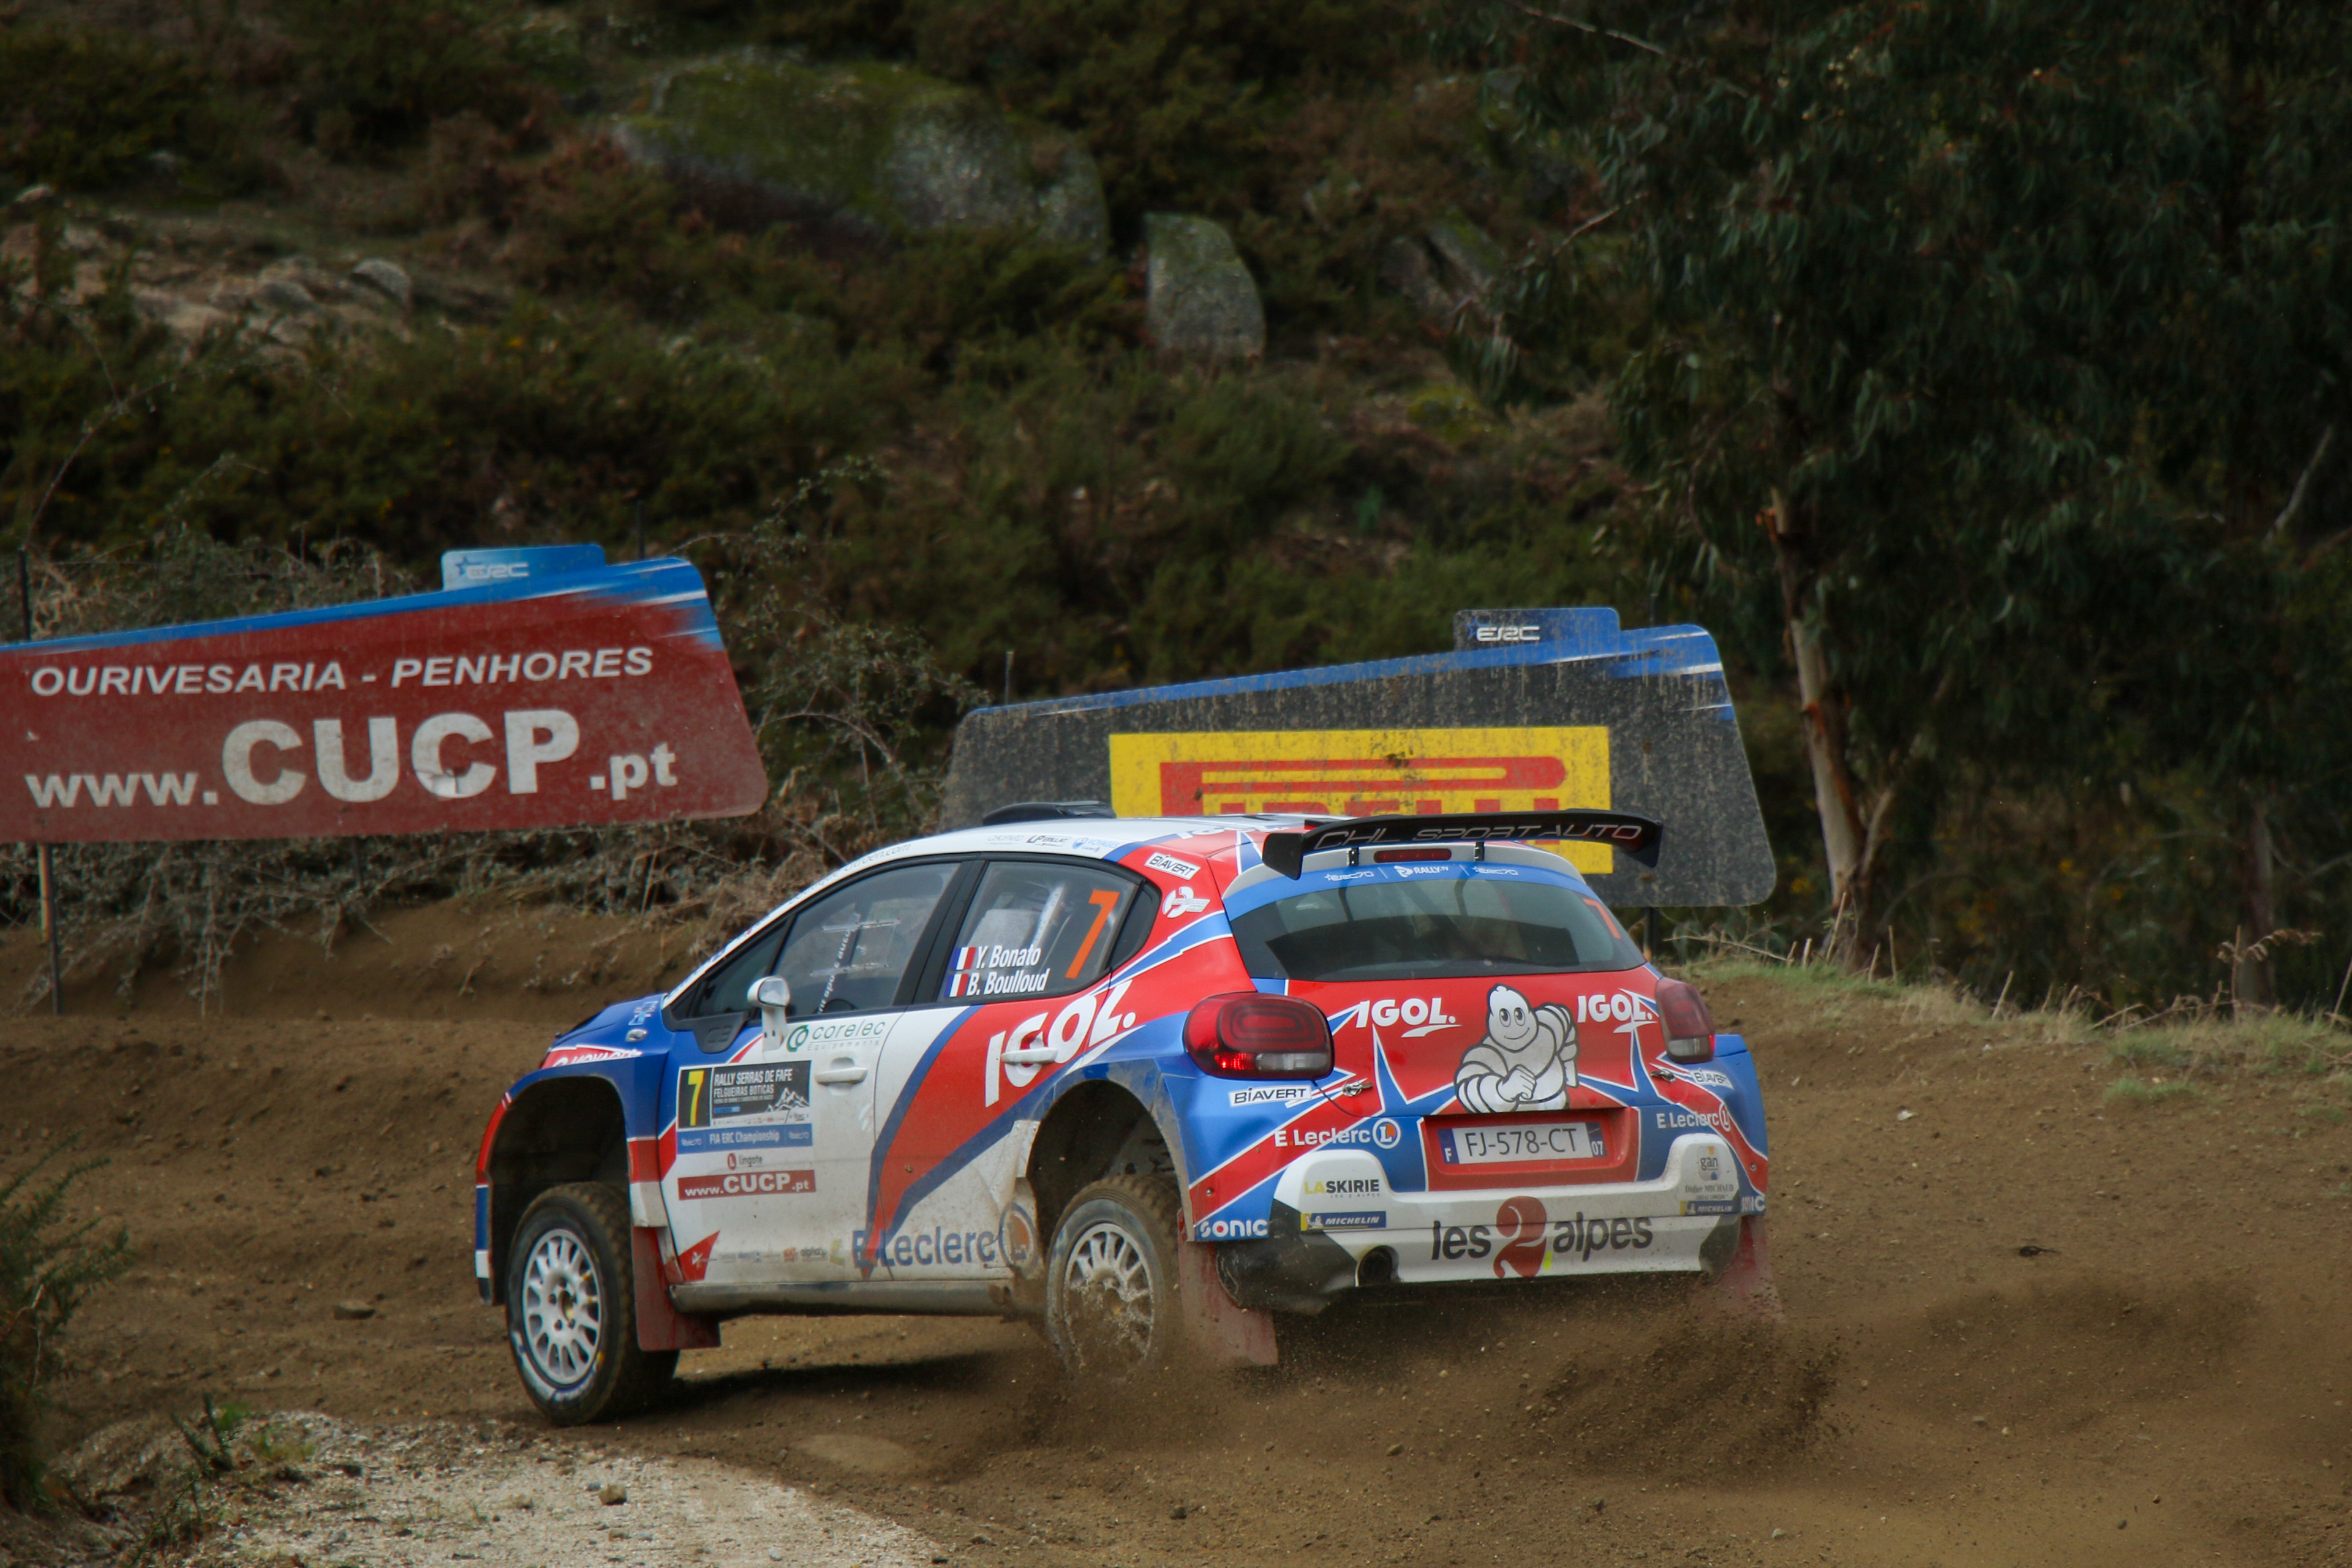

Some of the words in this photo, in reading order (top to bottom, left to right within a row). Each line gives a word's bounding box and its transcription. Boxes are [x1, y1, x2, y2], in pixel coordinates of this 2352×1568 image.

[1476, 626, 1540, 641] ERC
[31, 662, 345, 696] OURIVESARIA
[391, 647, 653, 688] PENHORES
[24, 709, 677, 807] www.CUCP.pt
[1314, 828, 1400, 850] CHL
[1412, 826, 1542, 841] SPORT
[1537, 824, 1642, 840] AUTO
[1065, 890, 1120, 979] 7
[976, 946, 989, 969] Y.
[989, 944, 1041, 968] Bonato
[967, 973, 981, 996] B.
[984, 968, 1050, 995] Boulloud
[813, 1019, 886, 1040] corelec
[714, 1072, 735, 1087] RALLY
[736, 1071, 764, 1085] SERRAS
[764, 1070, 774, 1083] DE
[775, 1068, 793, 1082] FAFE
[688, 1070, 704, 1126] 7
[709, 1133, 720, 1145] FIA
[736, 1130, 781, 1144] Championship
[1444, 1148, 1452, 1162] F
[1464, 1128, 1577, 1157] FJ-578-CT
[1592, 1140, 1604, 1156] 07
[1700, 1158, 1719, 1170] gan
[685, 1174, 809, 1197] www.CUCP.pt
[1325, 1216, 1380, 1225] MICHELIN
[1431, 1220, 1491, 1260] les
[1493, 1196, 1547, 1278] 2
[1552, 1212, 1653, 1262] alpes
